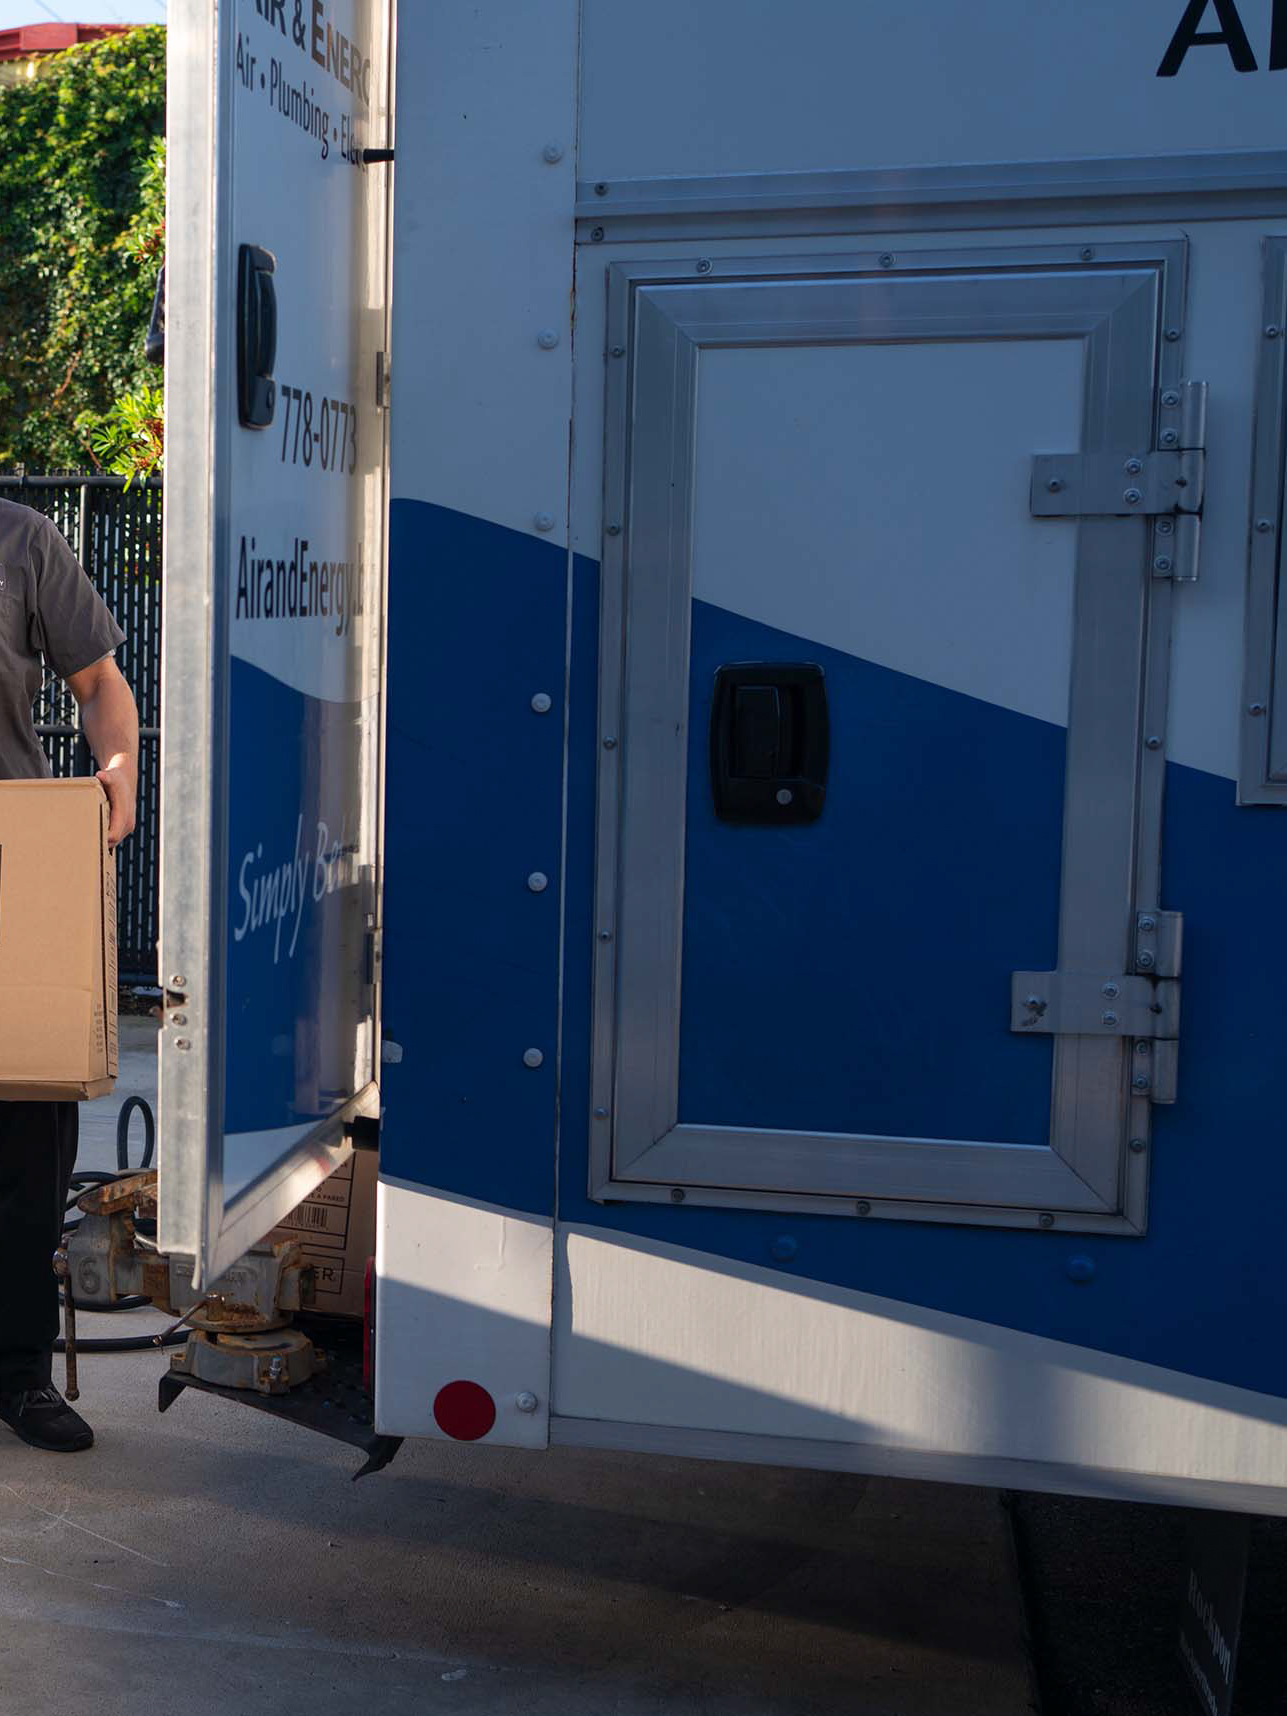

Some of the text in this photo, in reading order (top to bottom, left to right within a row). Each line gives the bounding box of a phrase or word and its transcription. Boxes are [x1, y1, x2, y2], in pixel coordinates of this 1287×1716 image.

[236, 32, 256, 91] Air
[269, 57, 329, 160] Plumbing
[281, 385, 357, 476] 778-0773
[234, 813, 310, 965] Simply
